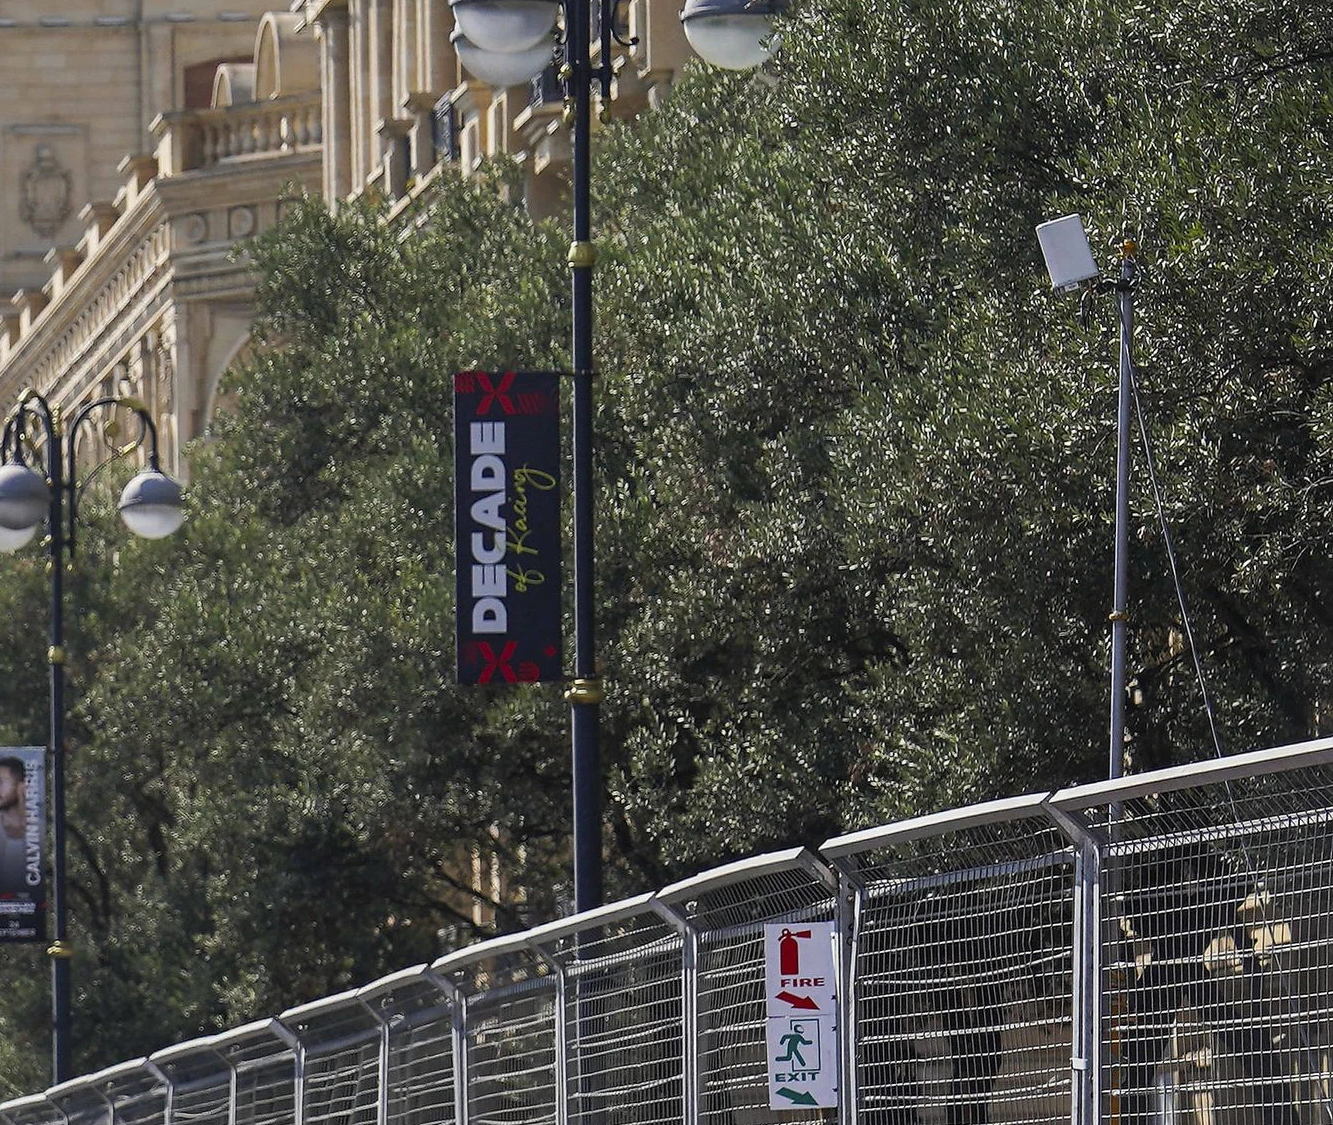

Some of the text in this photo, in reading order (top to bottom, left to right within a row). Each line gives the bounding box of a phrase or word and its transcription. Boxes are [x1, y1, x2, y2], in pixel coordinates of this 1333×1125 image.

[470, 421, 508, 634] DECADE
[501, 463, 556, 593] of Racing
[25, 825, 41, 886] CALVIN
[780, 977, 826, 988] FIRE
[775, 1071, 821, 1083] EXIT
